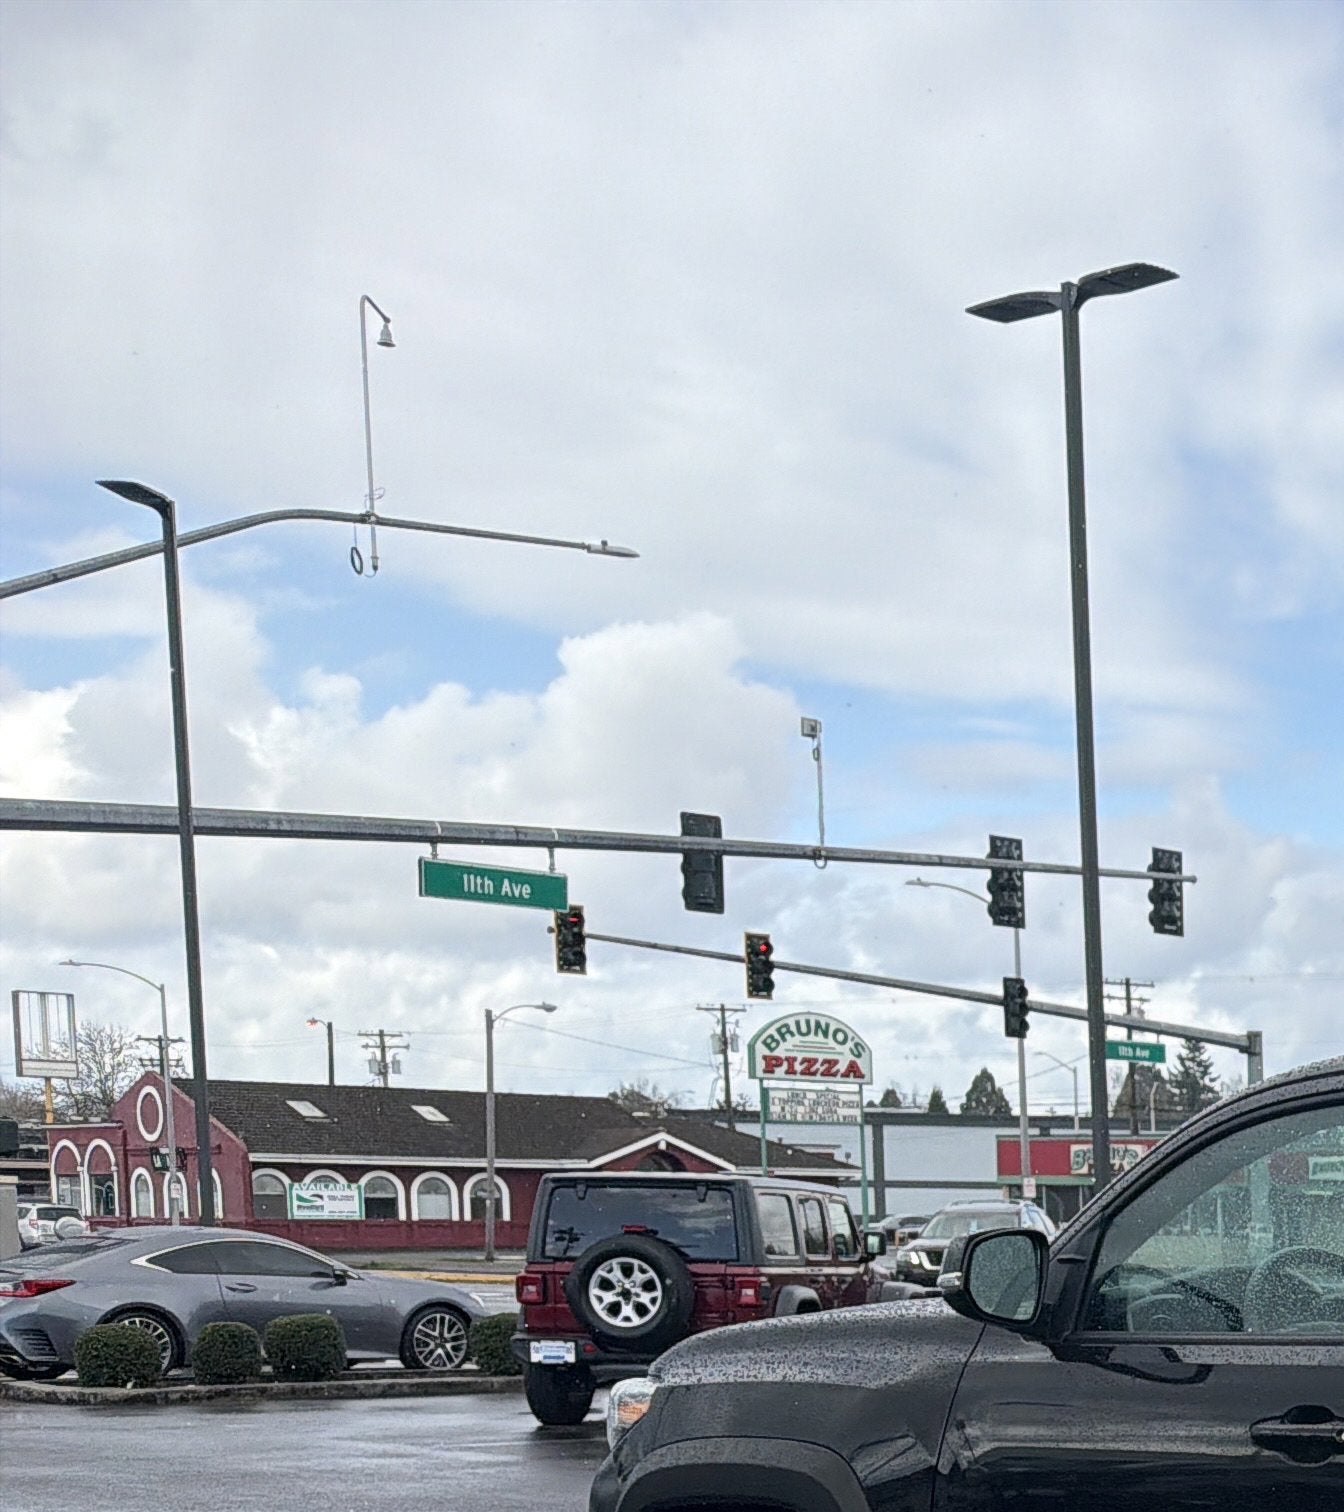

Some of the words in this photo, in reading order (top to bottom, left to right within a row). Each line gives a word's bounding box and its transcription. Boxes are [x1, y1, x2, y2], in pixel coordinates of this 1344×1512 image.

[463, 874, 494, 895] 11th
[501, 878, 532, 899] Ave
[761, 1018, 866, 1059] BRUNO'S
[762, 1055, 865, 1079] PIZZA
